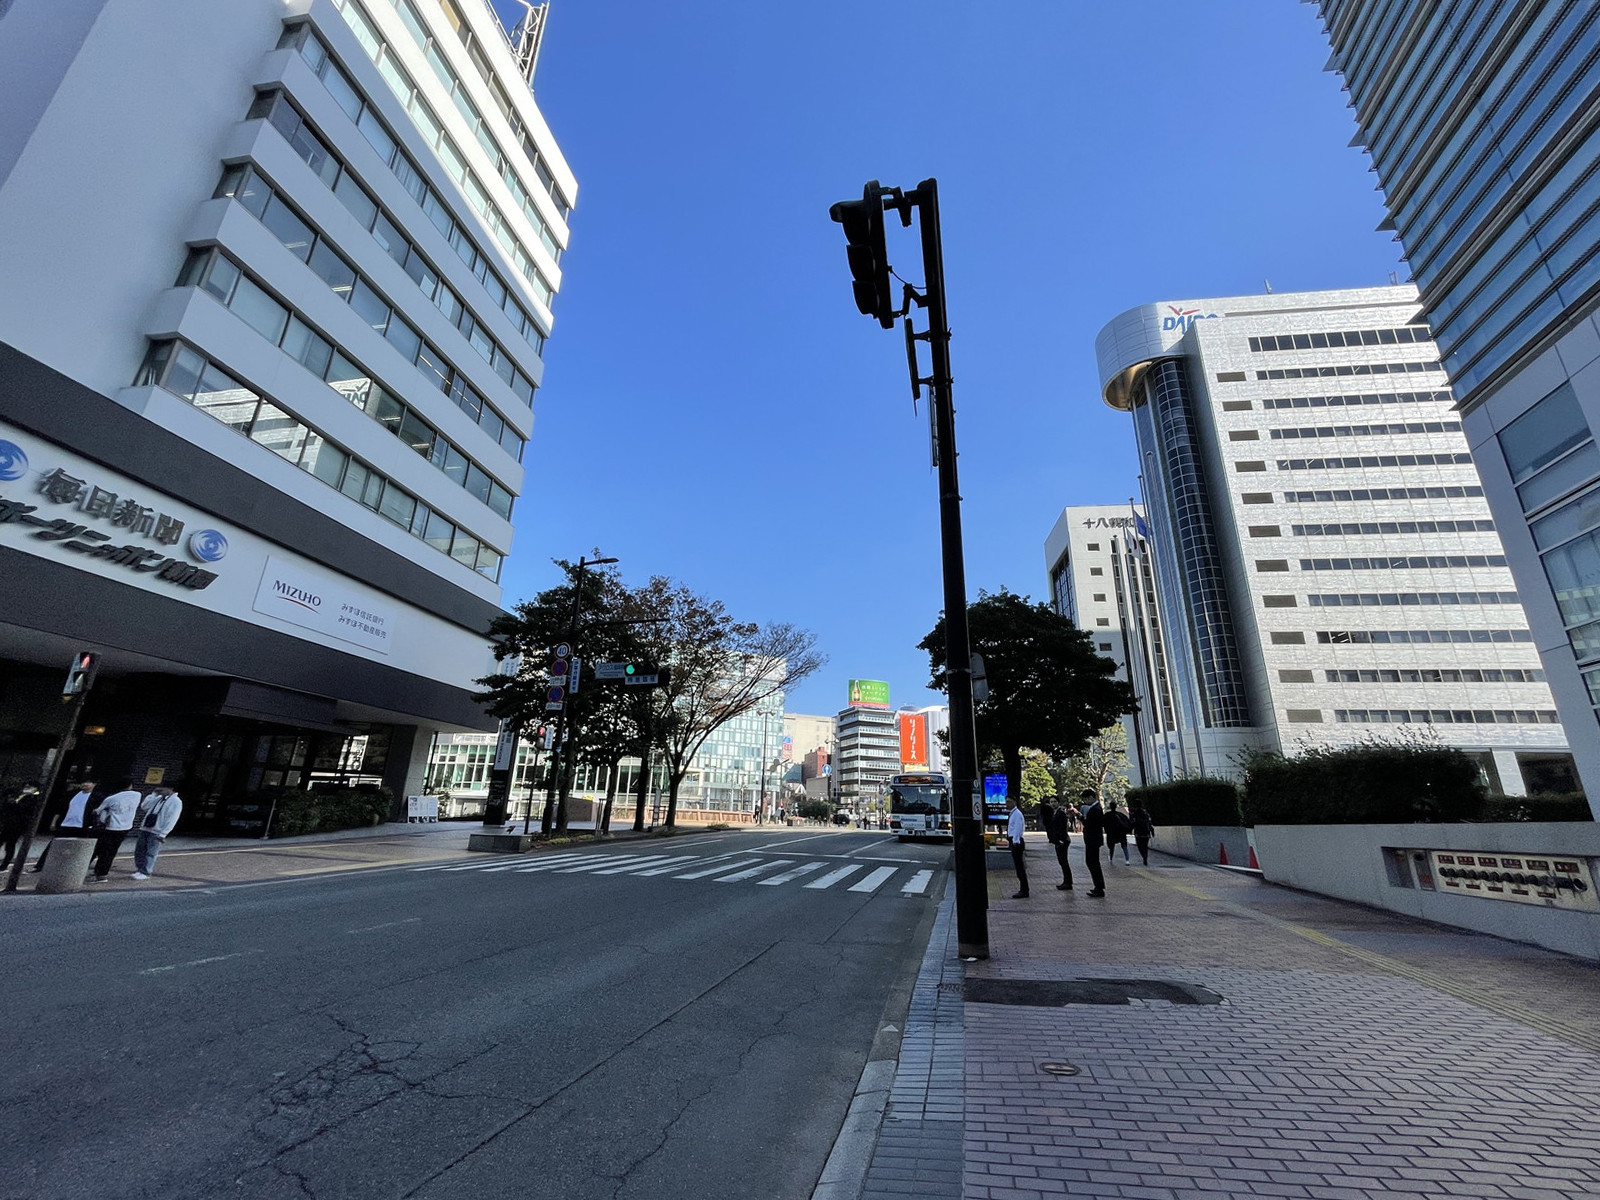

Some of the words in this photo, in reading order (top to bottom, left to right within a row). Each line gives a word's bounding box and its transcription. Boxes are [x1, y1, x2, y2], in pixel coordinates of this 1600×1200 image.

[40, 468, 186, 545] 毎日新聞
[273, 580, 321, 607] MIZUHO
[338, 615, 387, 639] みずほ不動産販売
[341, 603, 385, 626] みずほ信託銀行
[557, 646, 567, 655] 40
[909, 718, 917, 760] リノリース
